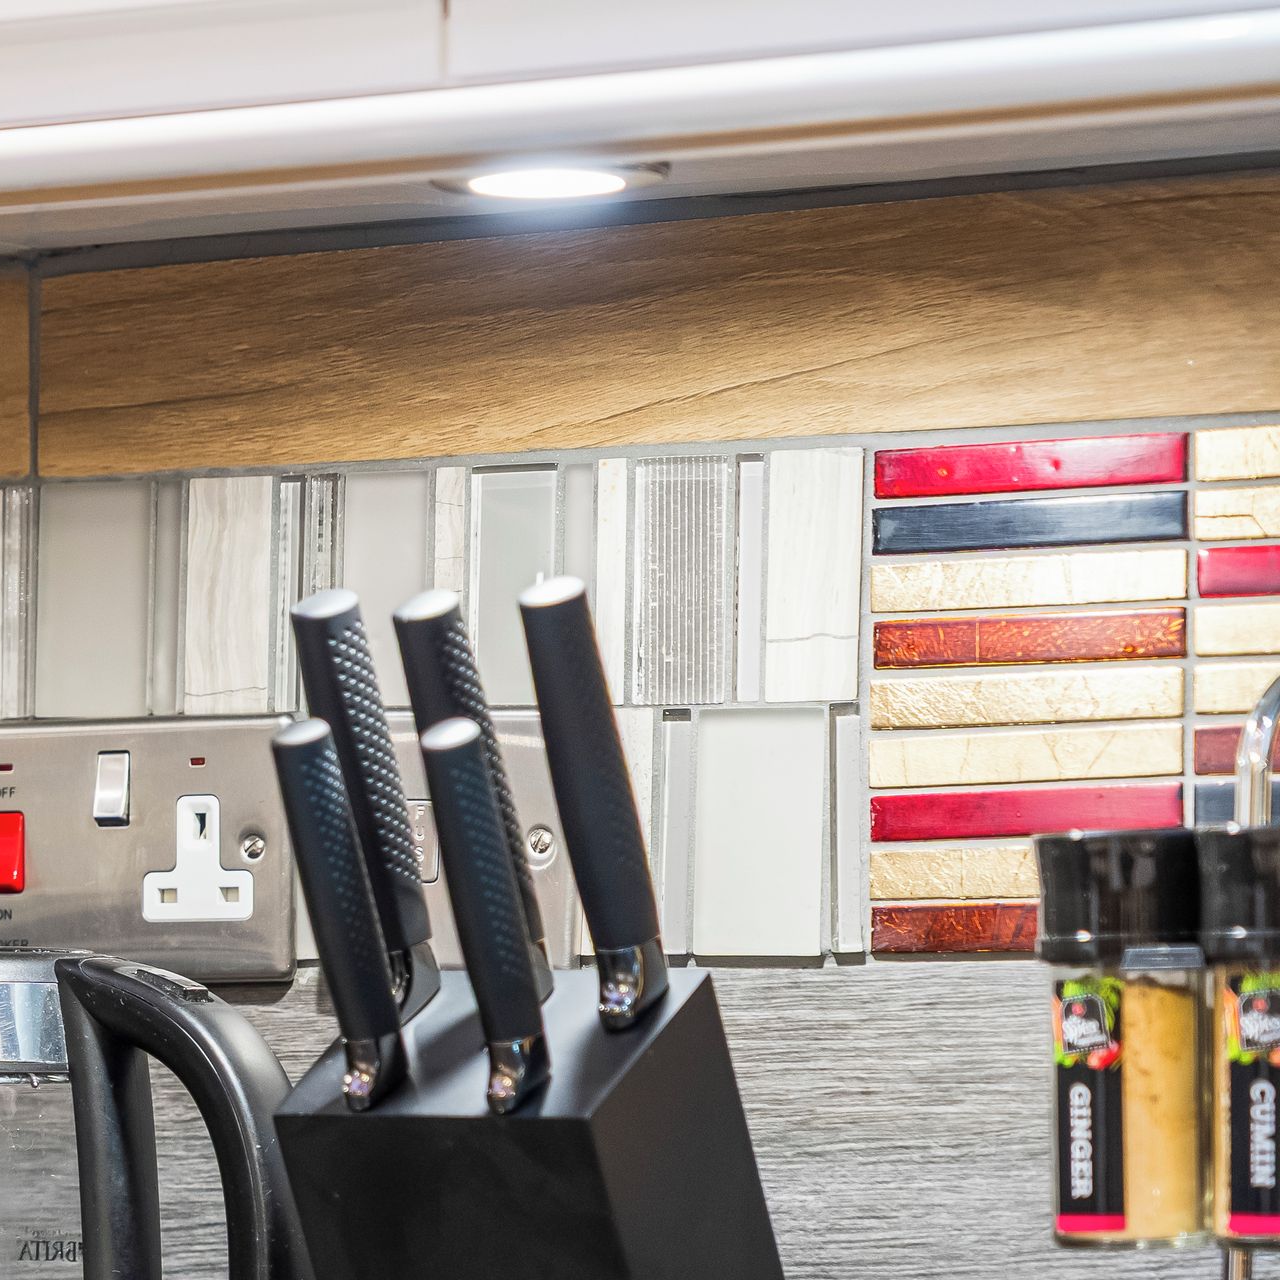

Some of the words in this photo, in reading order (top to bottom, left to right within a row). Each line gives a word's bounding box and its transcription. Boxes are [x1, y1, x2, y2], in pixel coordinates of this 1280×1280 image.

[413, 804, 426, 877] FUS
[1069, 1081, 1093, 1199] GINGER
[1249, 1079, 1276, 1189] CUMIN
